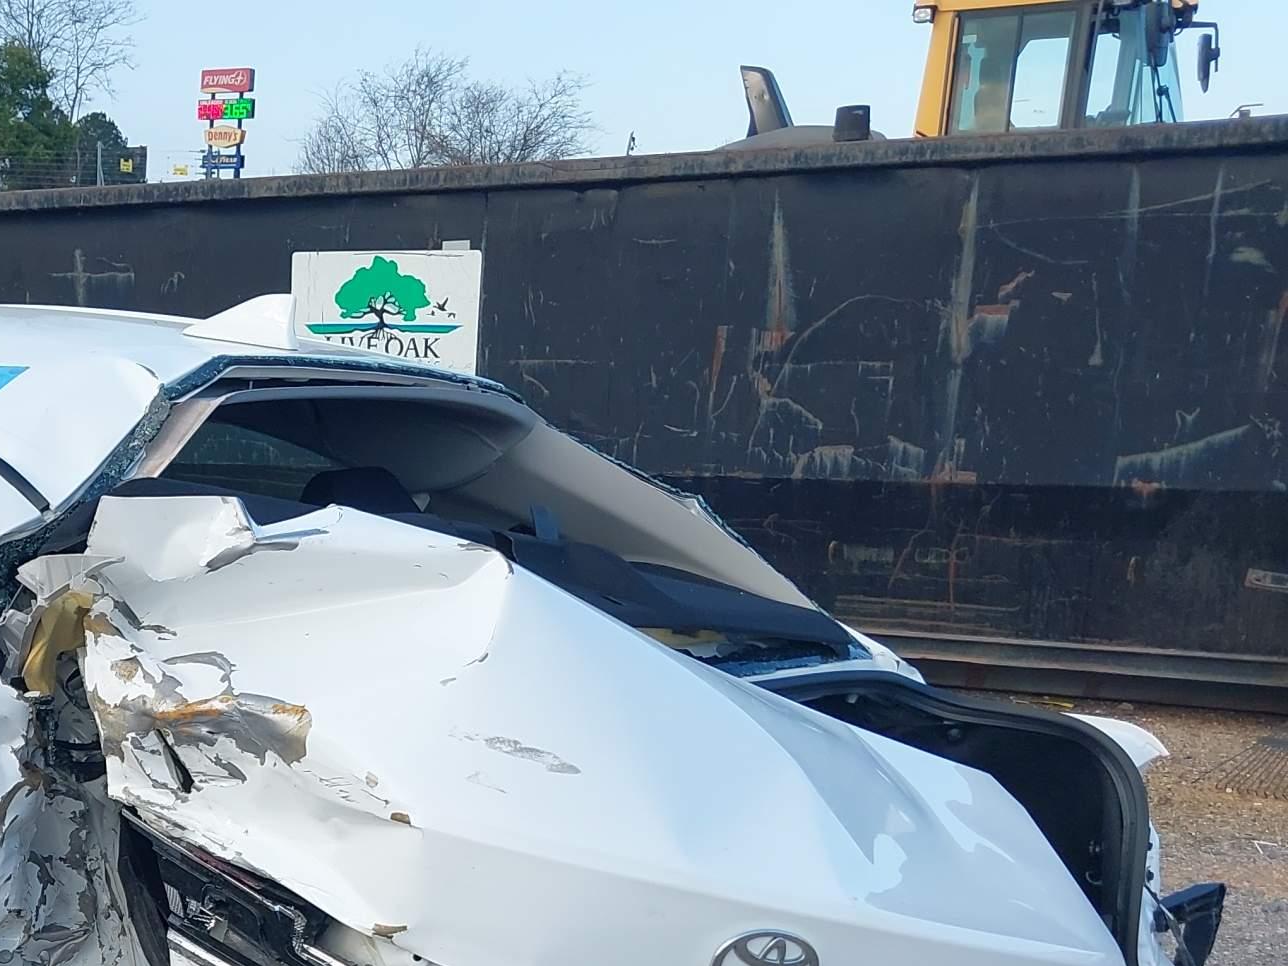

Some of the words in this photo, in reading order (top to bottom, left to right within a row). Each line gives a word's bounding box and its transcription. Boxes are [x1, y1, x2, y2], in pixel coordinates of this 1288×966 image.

[203, 74, 235, 86] FLYING
[208, 130, 238, 142] Denny's
[324, 336, 378, 350] VE
[384, 337, 441, 359] OAK
